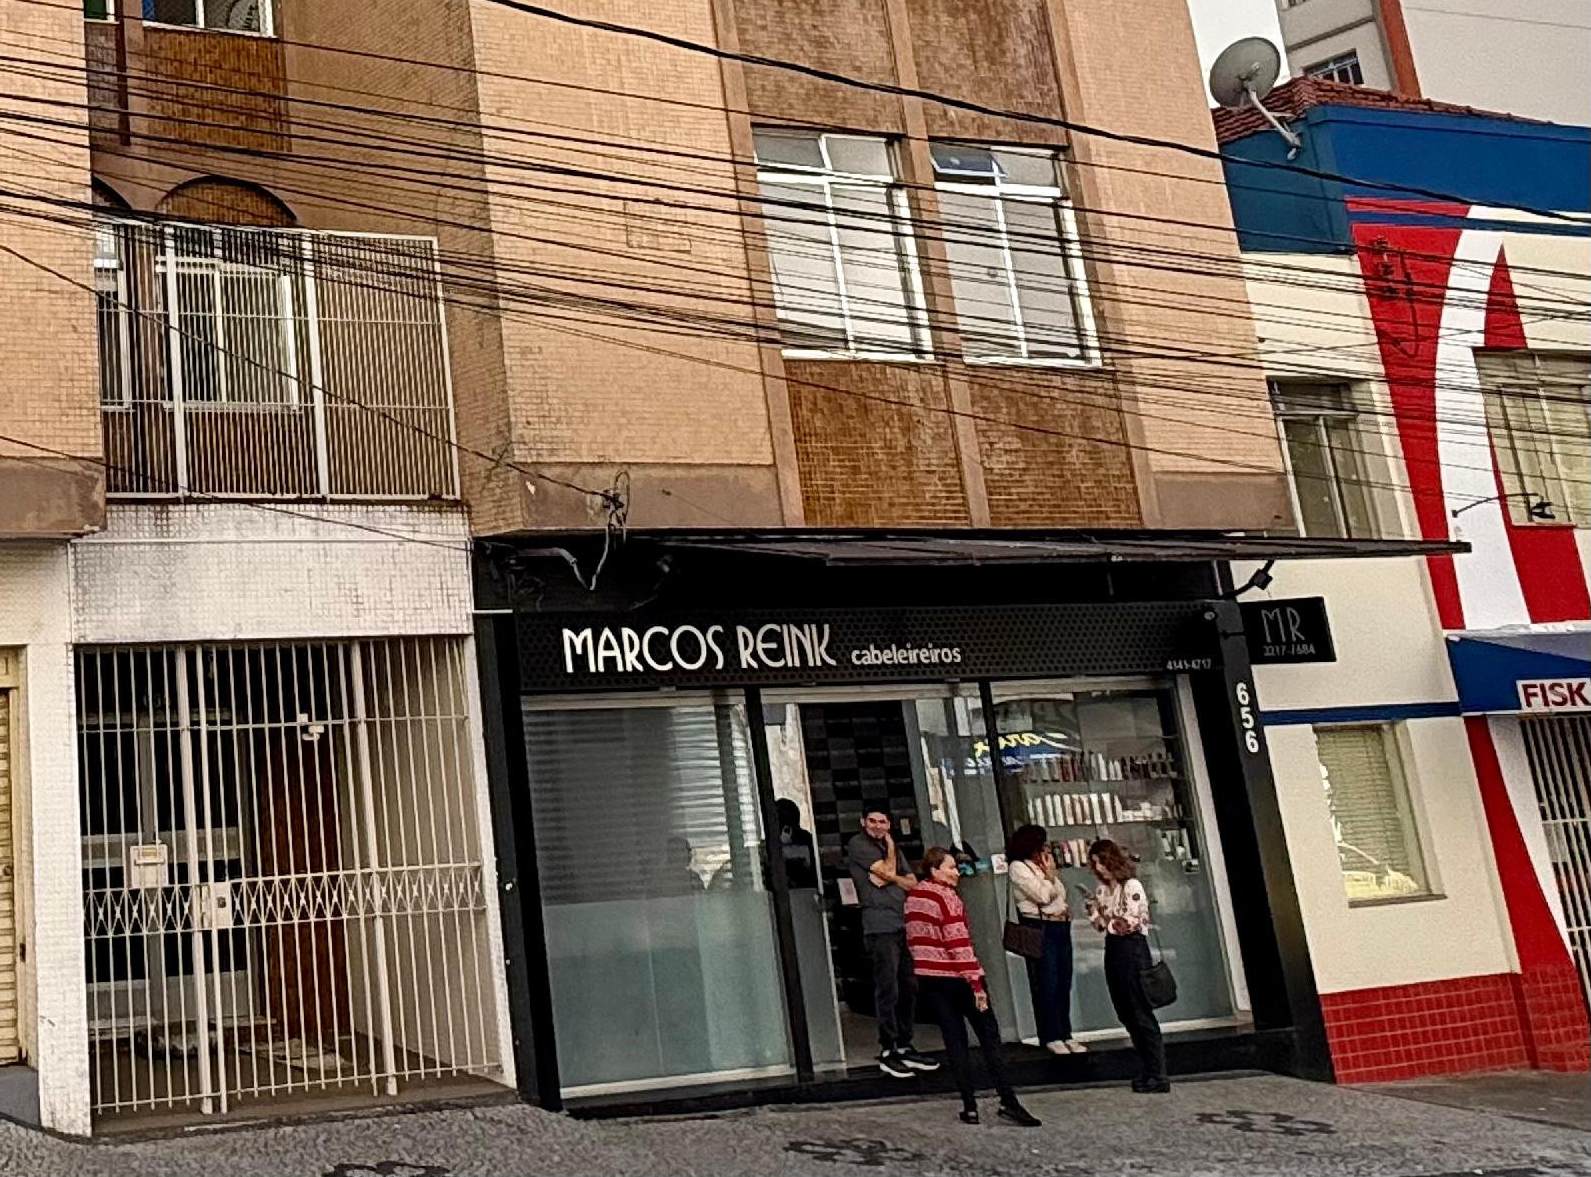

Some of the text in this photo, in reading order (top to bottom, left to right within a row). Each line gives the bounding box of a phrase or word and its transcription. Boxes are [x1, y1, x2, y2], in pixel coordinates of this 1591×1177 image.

[1261, 607, 1305, 643] MR
[562, 623, 962, 673] MARCOS REINK cabeleireiros
[1521, 682, 1591, 708] FISK
[1236, 682, 1259, 753] 656
